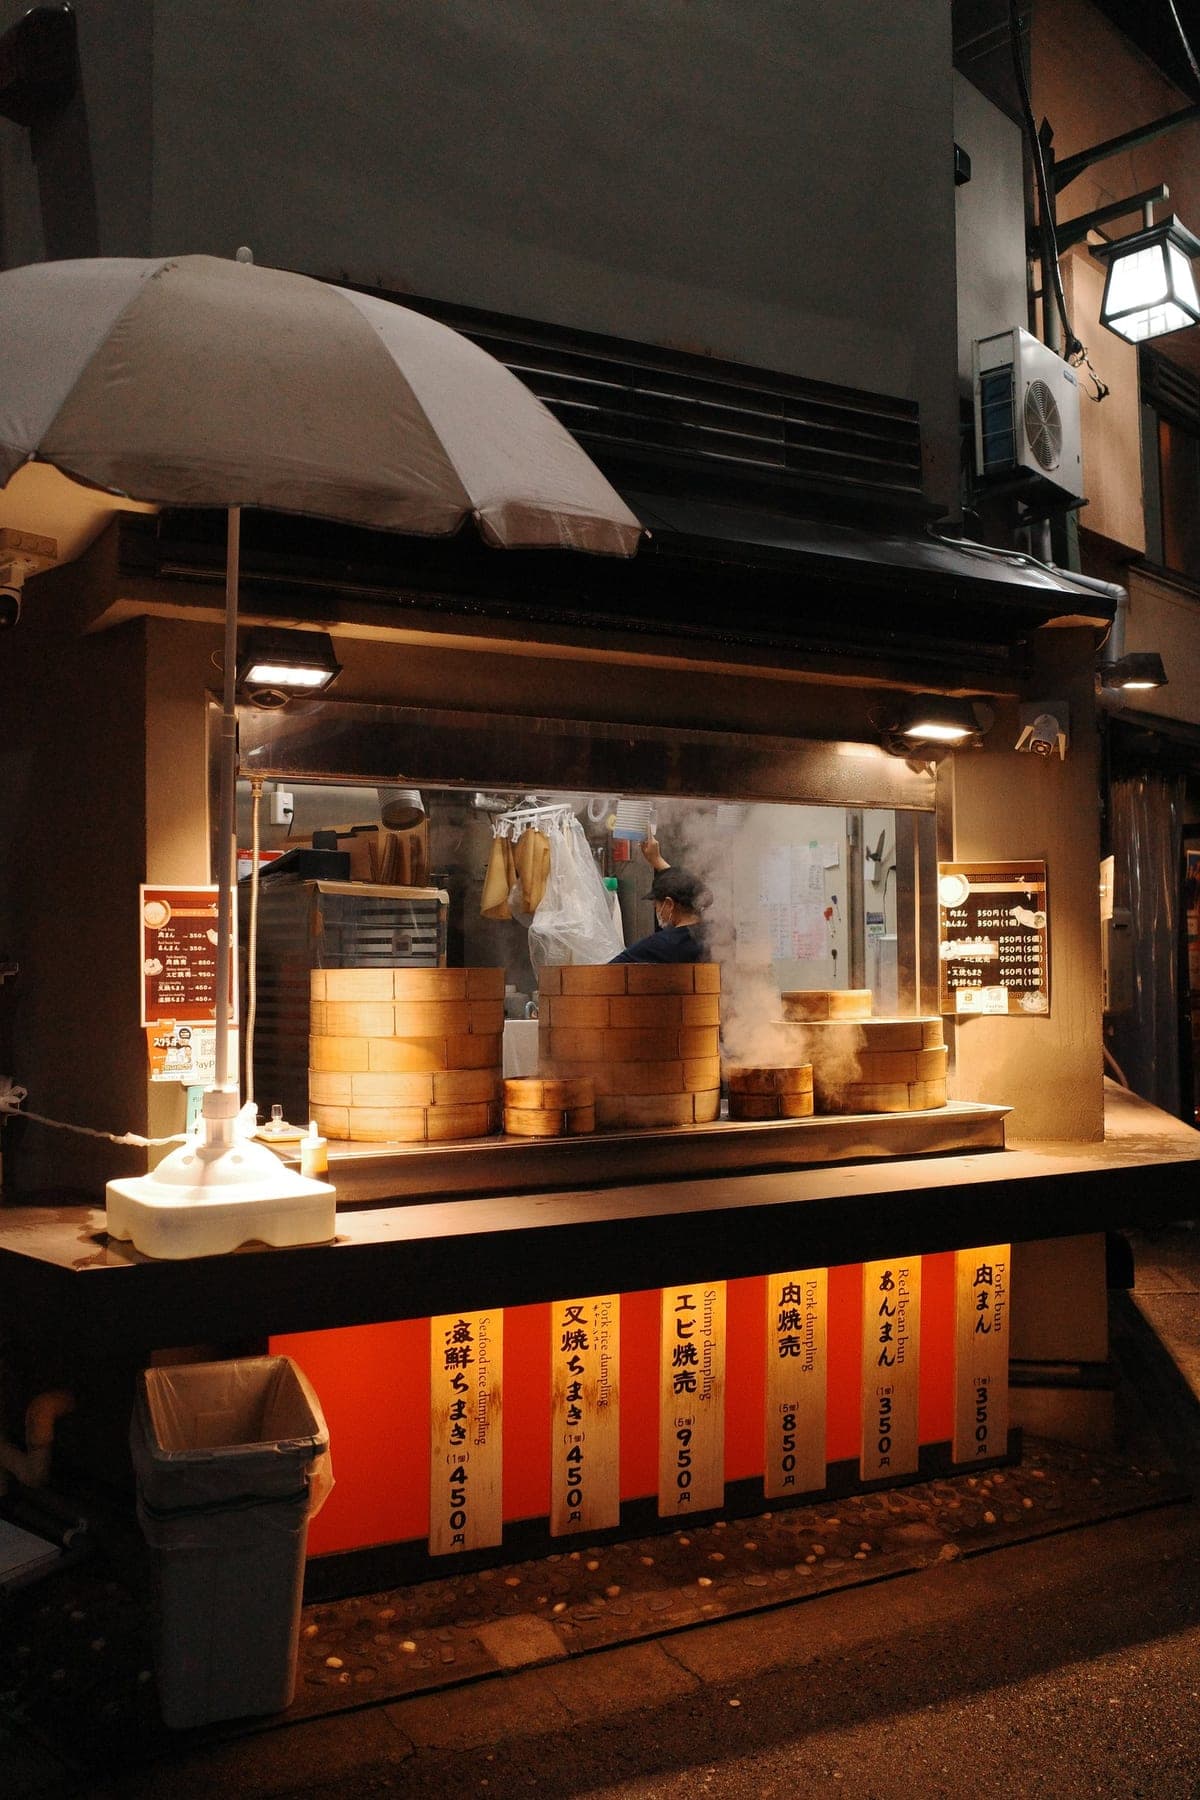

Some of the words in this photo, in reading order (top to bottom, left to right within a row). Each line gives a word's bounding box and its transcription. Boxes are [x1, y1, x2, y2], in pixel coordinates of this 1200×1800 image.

[806, 1281, 817, 1310] Pork
[898, 1269, 909, 1296] Red
[973, 1264, 992, 1334] 肉まん
[994, 1263, 1005, 1298] Pork
[479, 1318, 490, 1363] Seafood
[601, 1302, 611, 1327] Pork
[601, 1330, 611, 1350] rice
[700, 1290, 716, 1336] Shrimp
[777, 1282, 802, 1358] 肉焼売
[802, 1313, 817, 1372] dumpling
[878, 1270, 896, 1367] あんまん
[898, 1300, 909, 1333] bean
[994, 1303, 1005, 1332] bun
[560, 1306, 589, 1425] 叉焼ちまき
[672, 1294, 699, 1394] エビ焼売
[699, 1340, 716, 1400] dumpling
[897, 1336, 909, 1363] bun
[444, 1319, 475, 1446] 海鮮ちまき
[479, 1366, 488, 1387] rice
[597, 1353, 612, 1408] dumpling
[474, 1390, 490, 1446] dumpling
[878, 1397, 892, 1469] 350円
[975, 1387, 988, 1456] 350円
[677, 1429, 692, 1504] 950円
[782, 1414, 796, 1487] 850円
[449, 1465, 468, 1547] 450円
[567, 1446, 583, 1523] 450円
